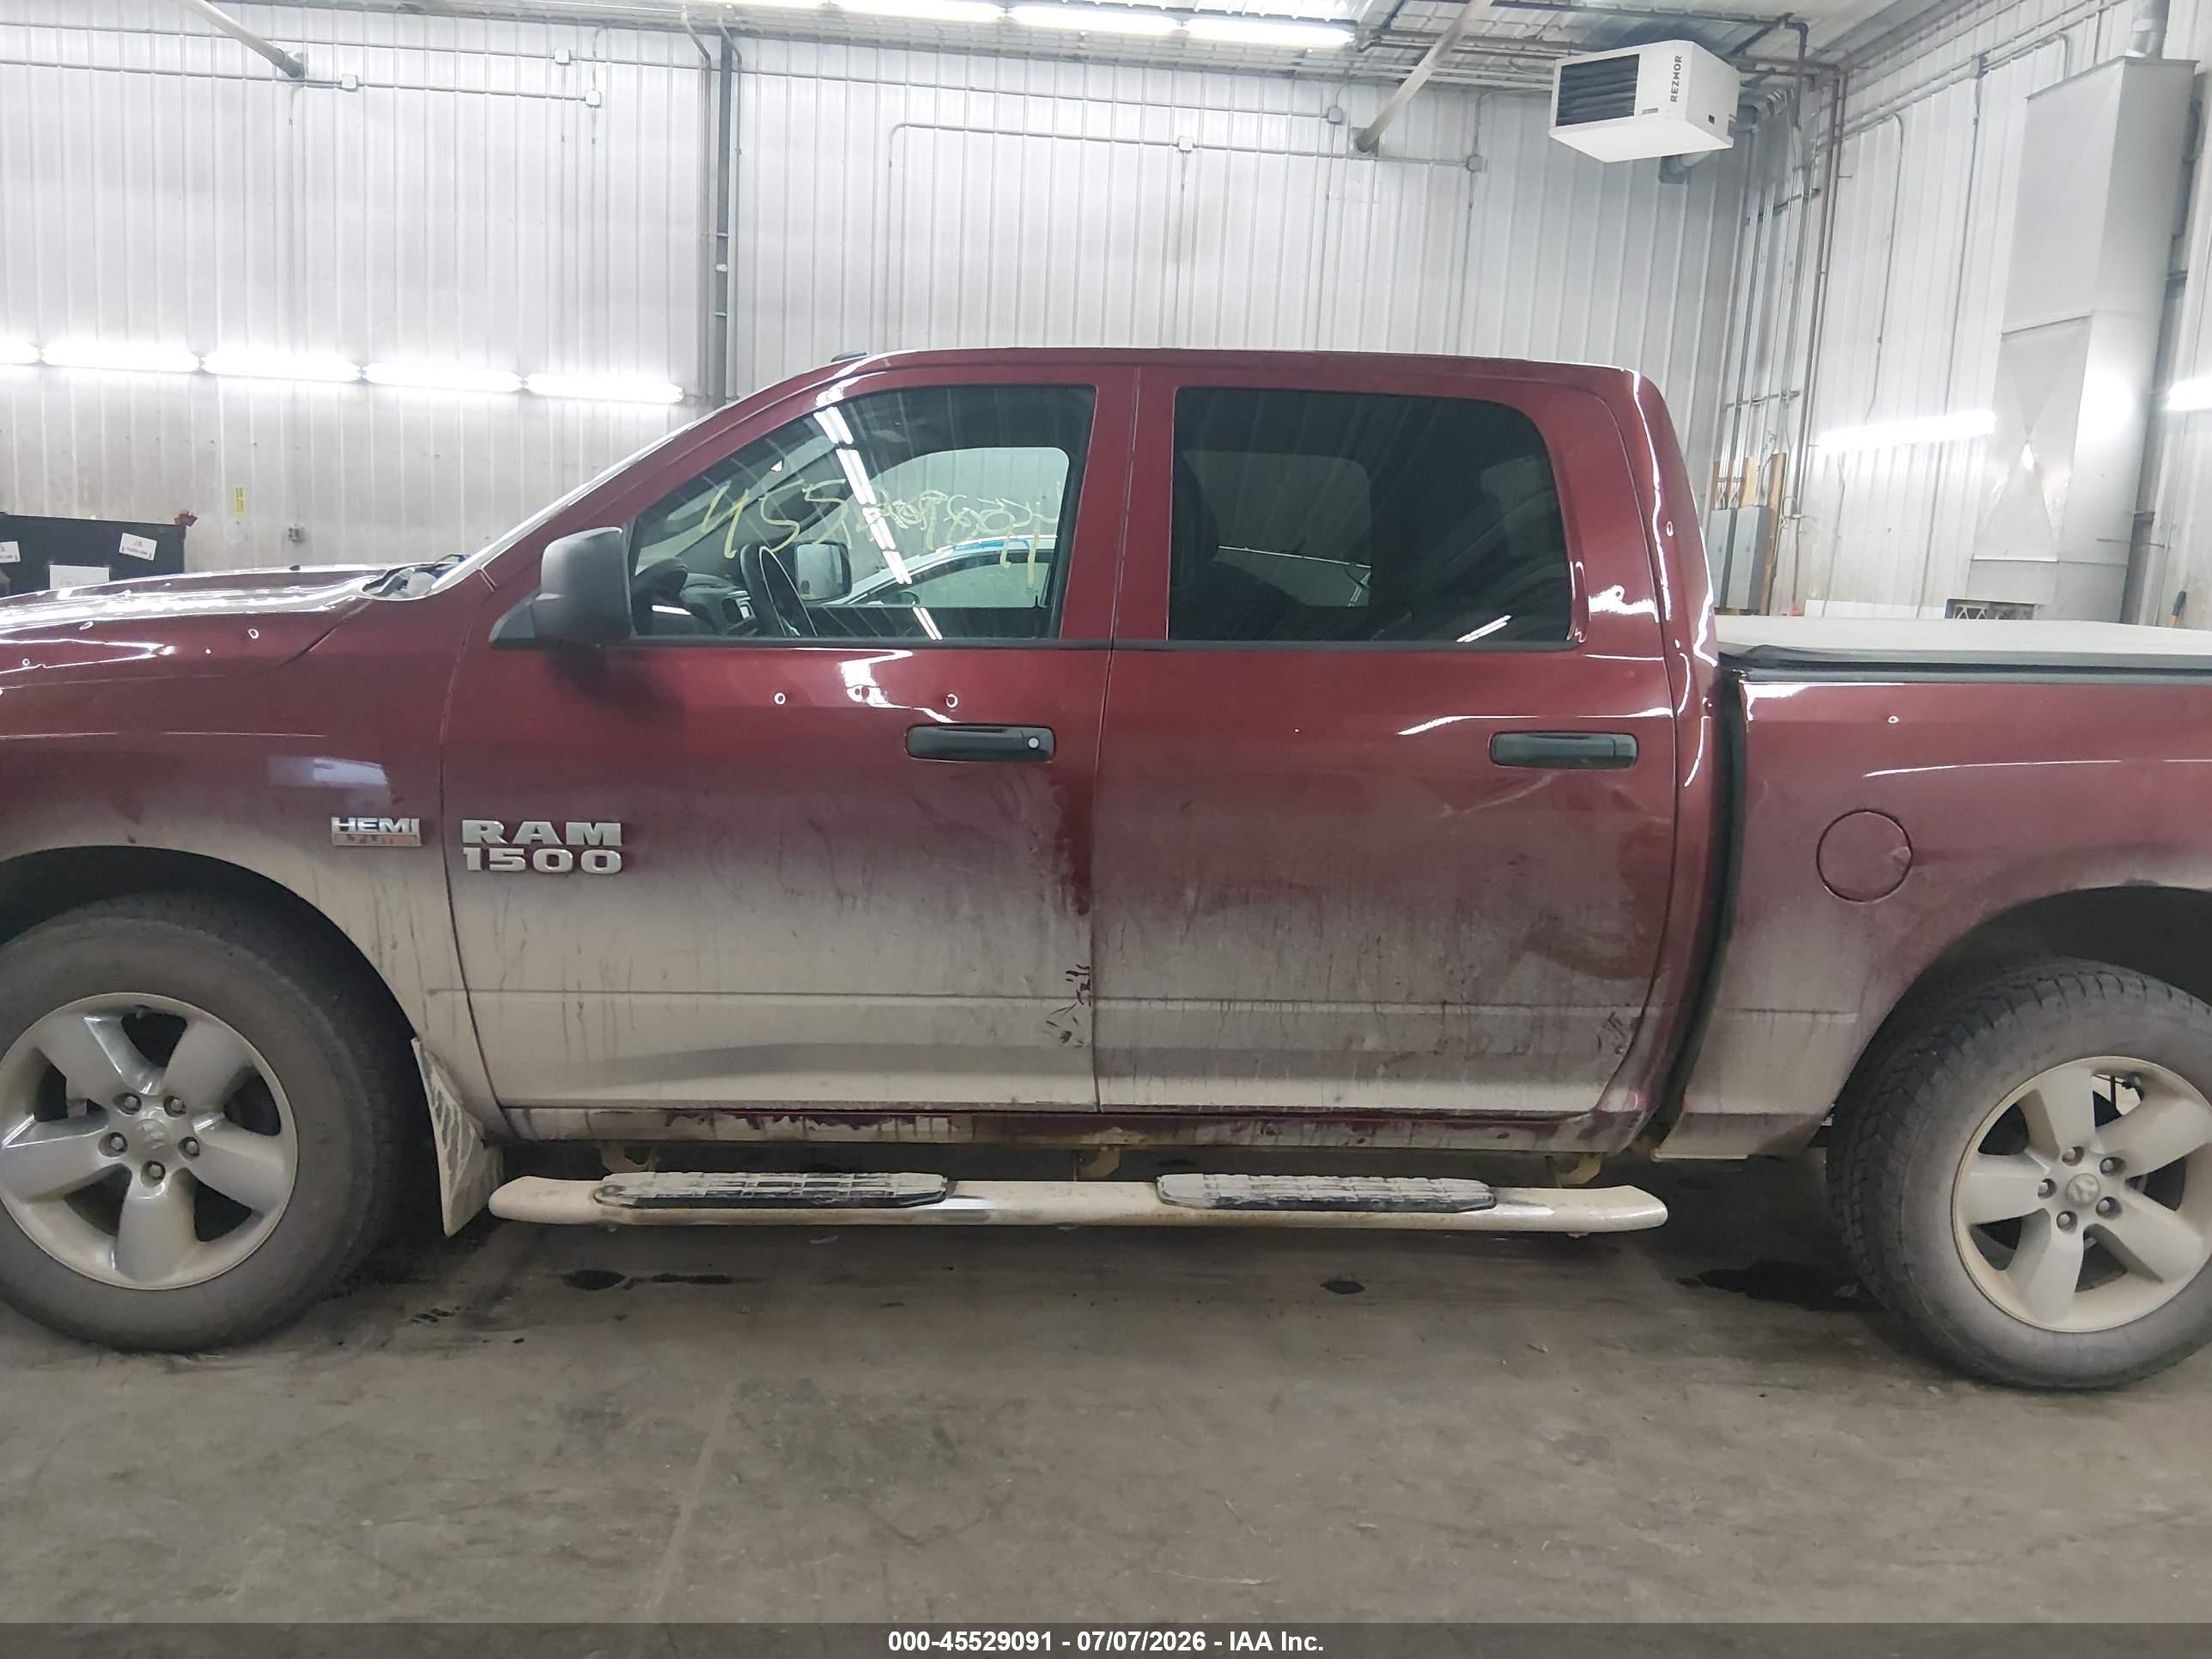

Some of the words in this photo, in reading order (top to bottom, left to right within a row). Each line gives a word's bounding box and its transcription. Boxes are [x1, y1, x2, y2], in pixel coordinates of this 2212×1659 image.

[1669, 54, 1684, 103] REZNOR
[331, 817, 420, 833] HEMI
[462, 819, 623, 847] RAM
[463, 847, 623, 874] 1500
